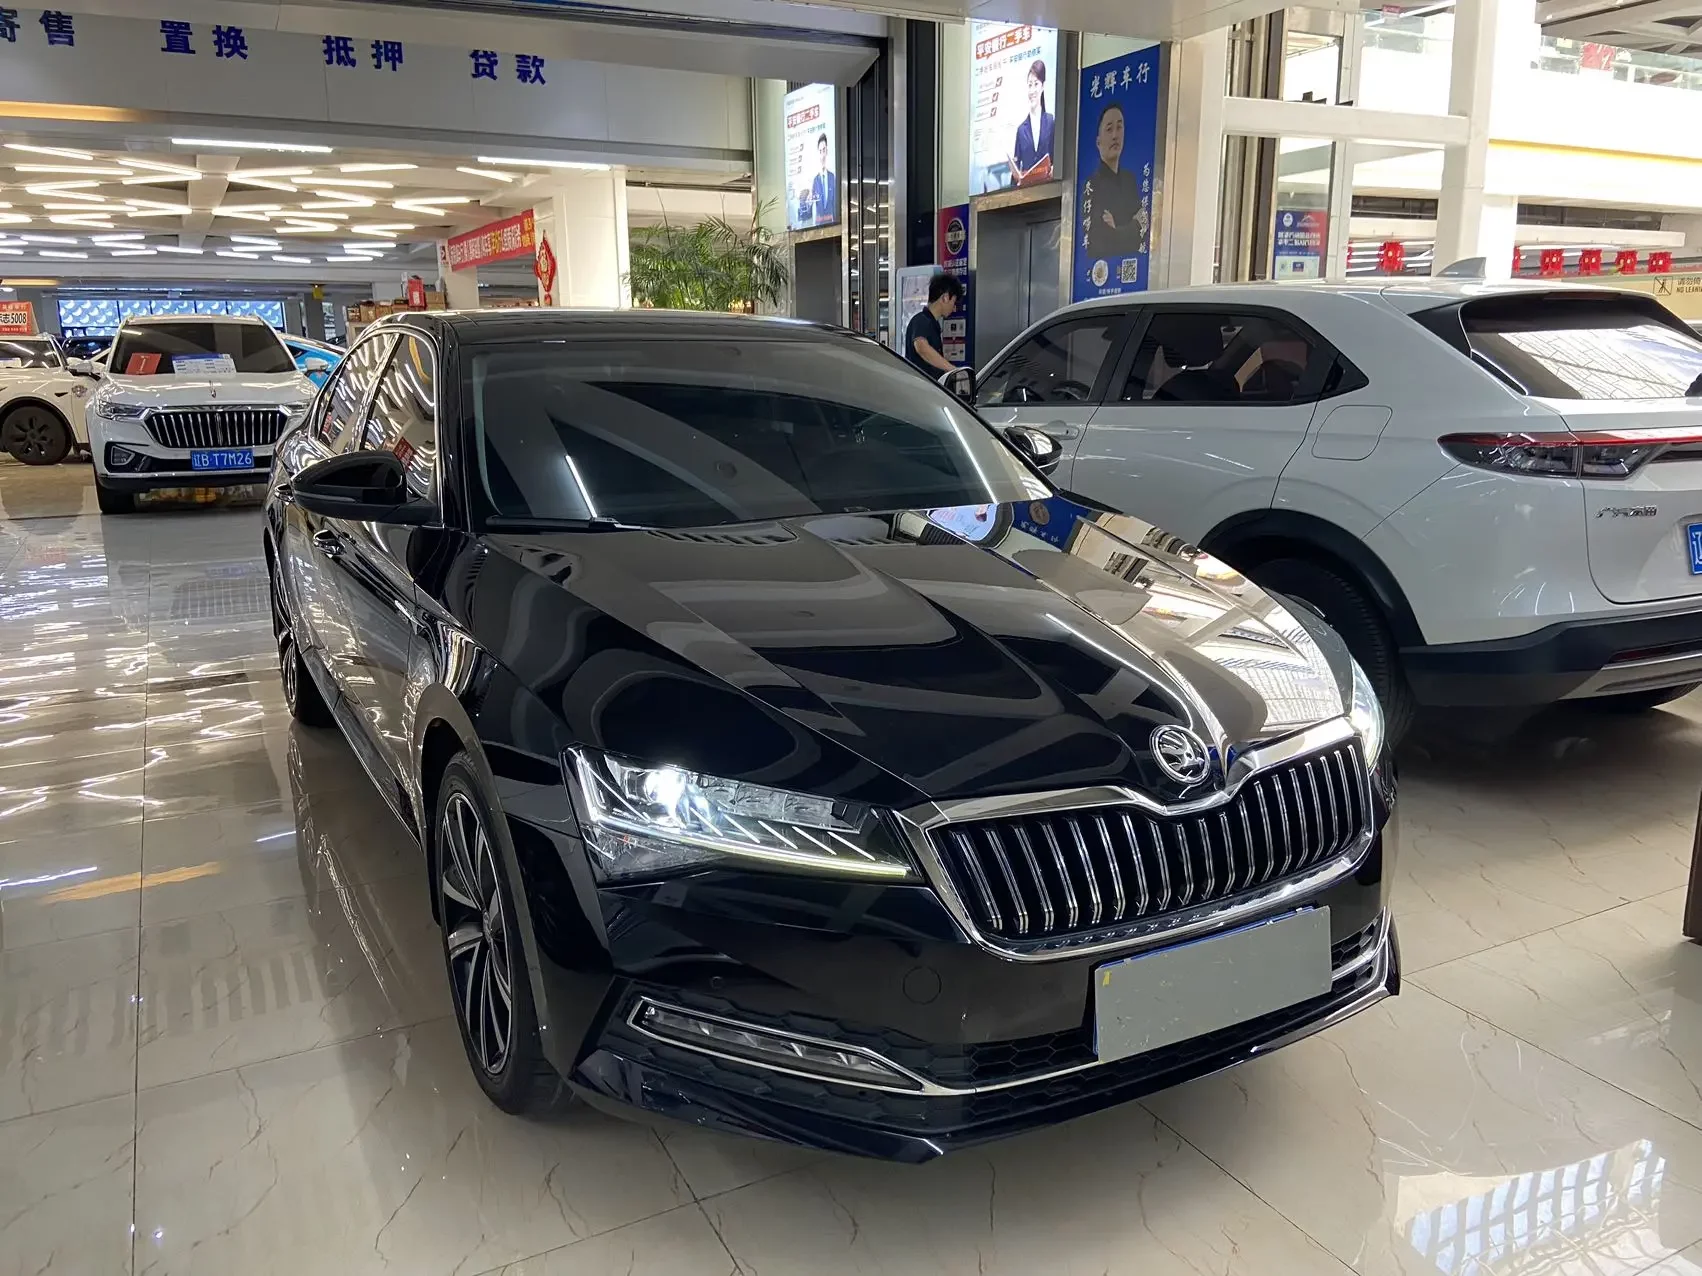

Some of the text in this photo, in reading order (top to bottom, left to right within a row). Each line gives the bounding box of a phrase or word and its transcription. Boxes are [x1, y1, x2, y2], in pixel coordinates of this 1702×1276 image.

[160, 19, 248, 60] 置换
[322, 35, 404, 72] 抵押
[469, 49, 546, 85] 贷款
